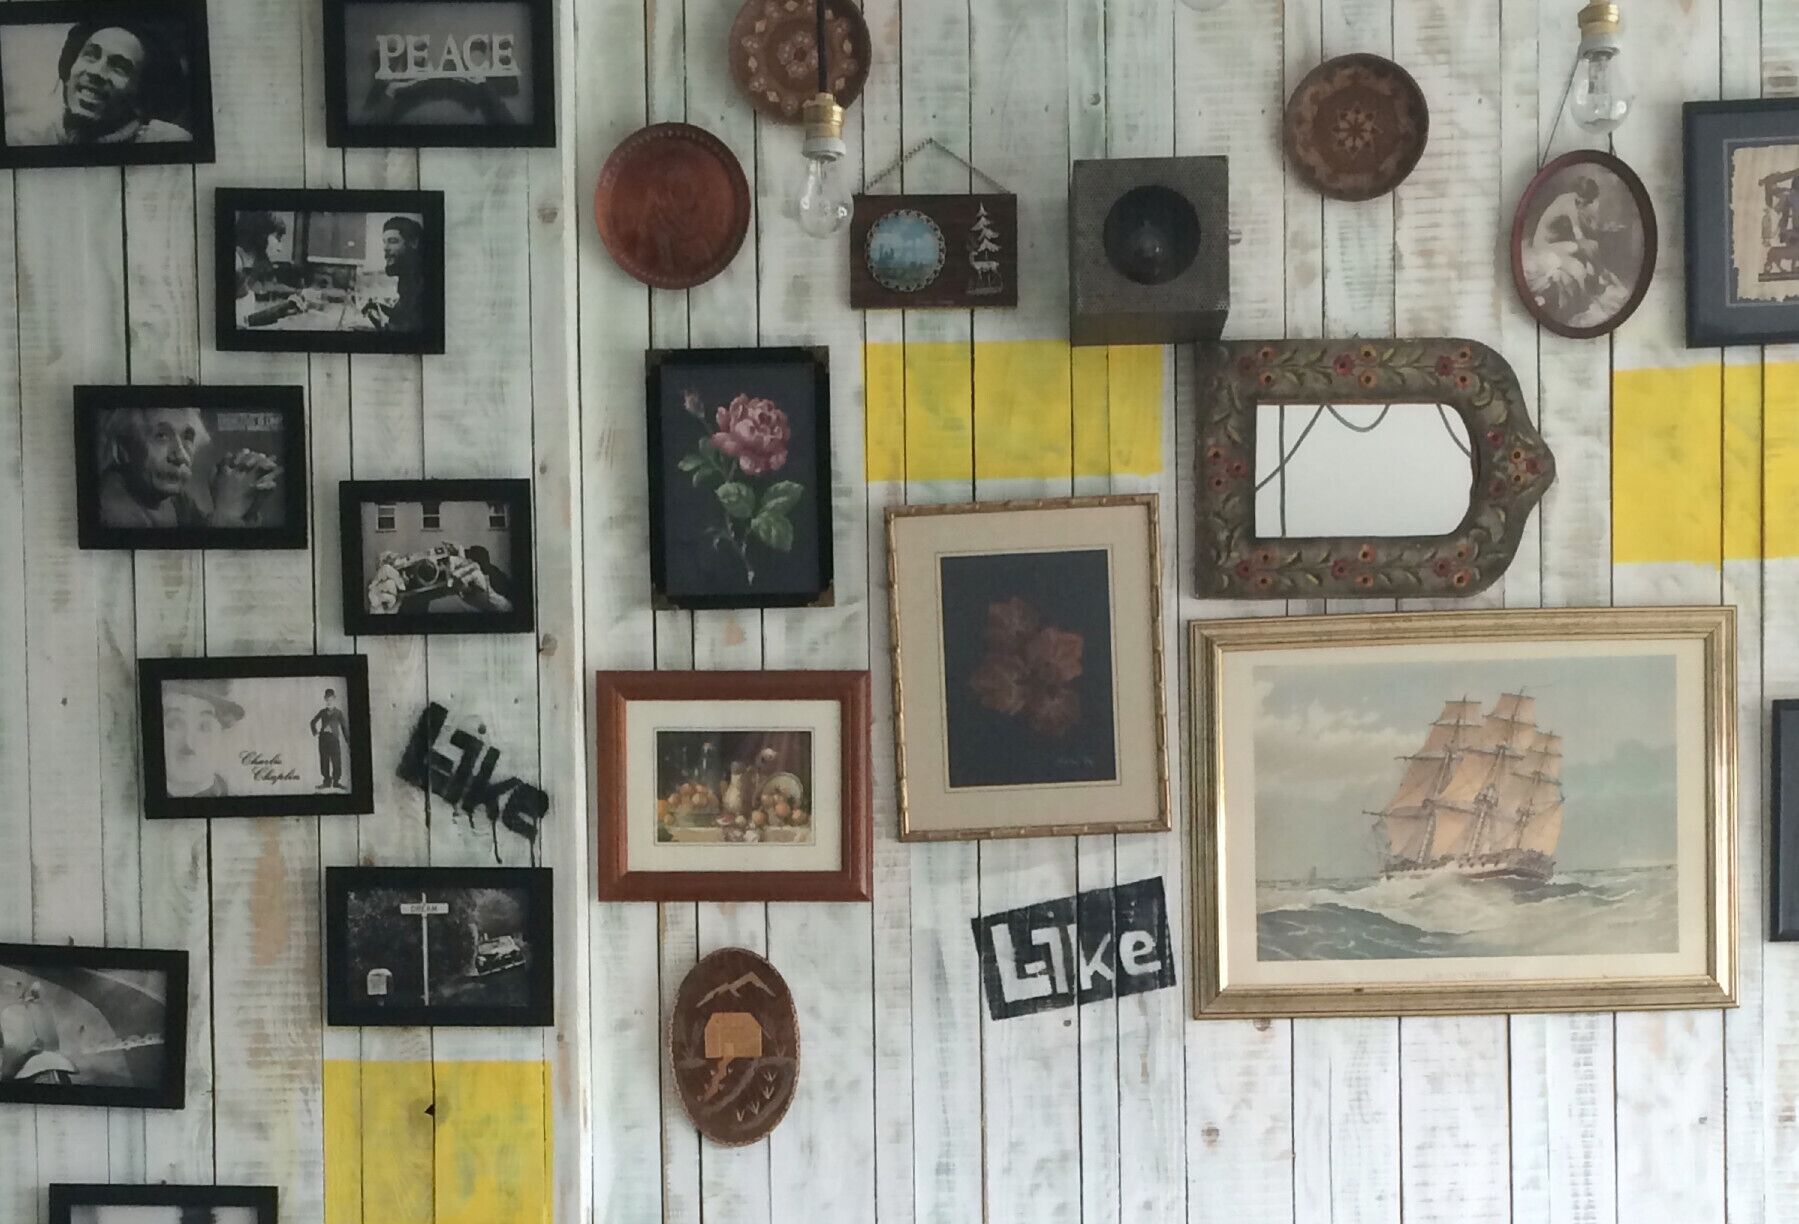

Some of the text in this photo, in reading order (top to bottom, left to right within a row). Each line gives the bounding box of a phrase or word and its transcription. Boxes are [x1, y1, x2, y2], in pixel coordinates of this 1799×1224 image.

[375, 33, 521, 78] PEACE
[239, 750, 282, 765] Charlie
[251, 767, 300, 785] Chaplin
